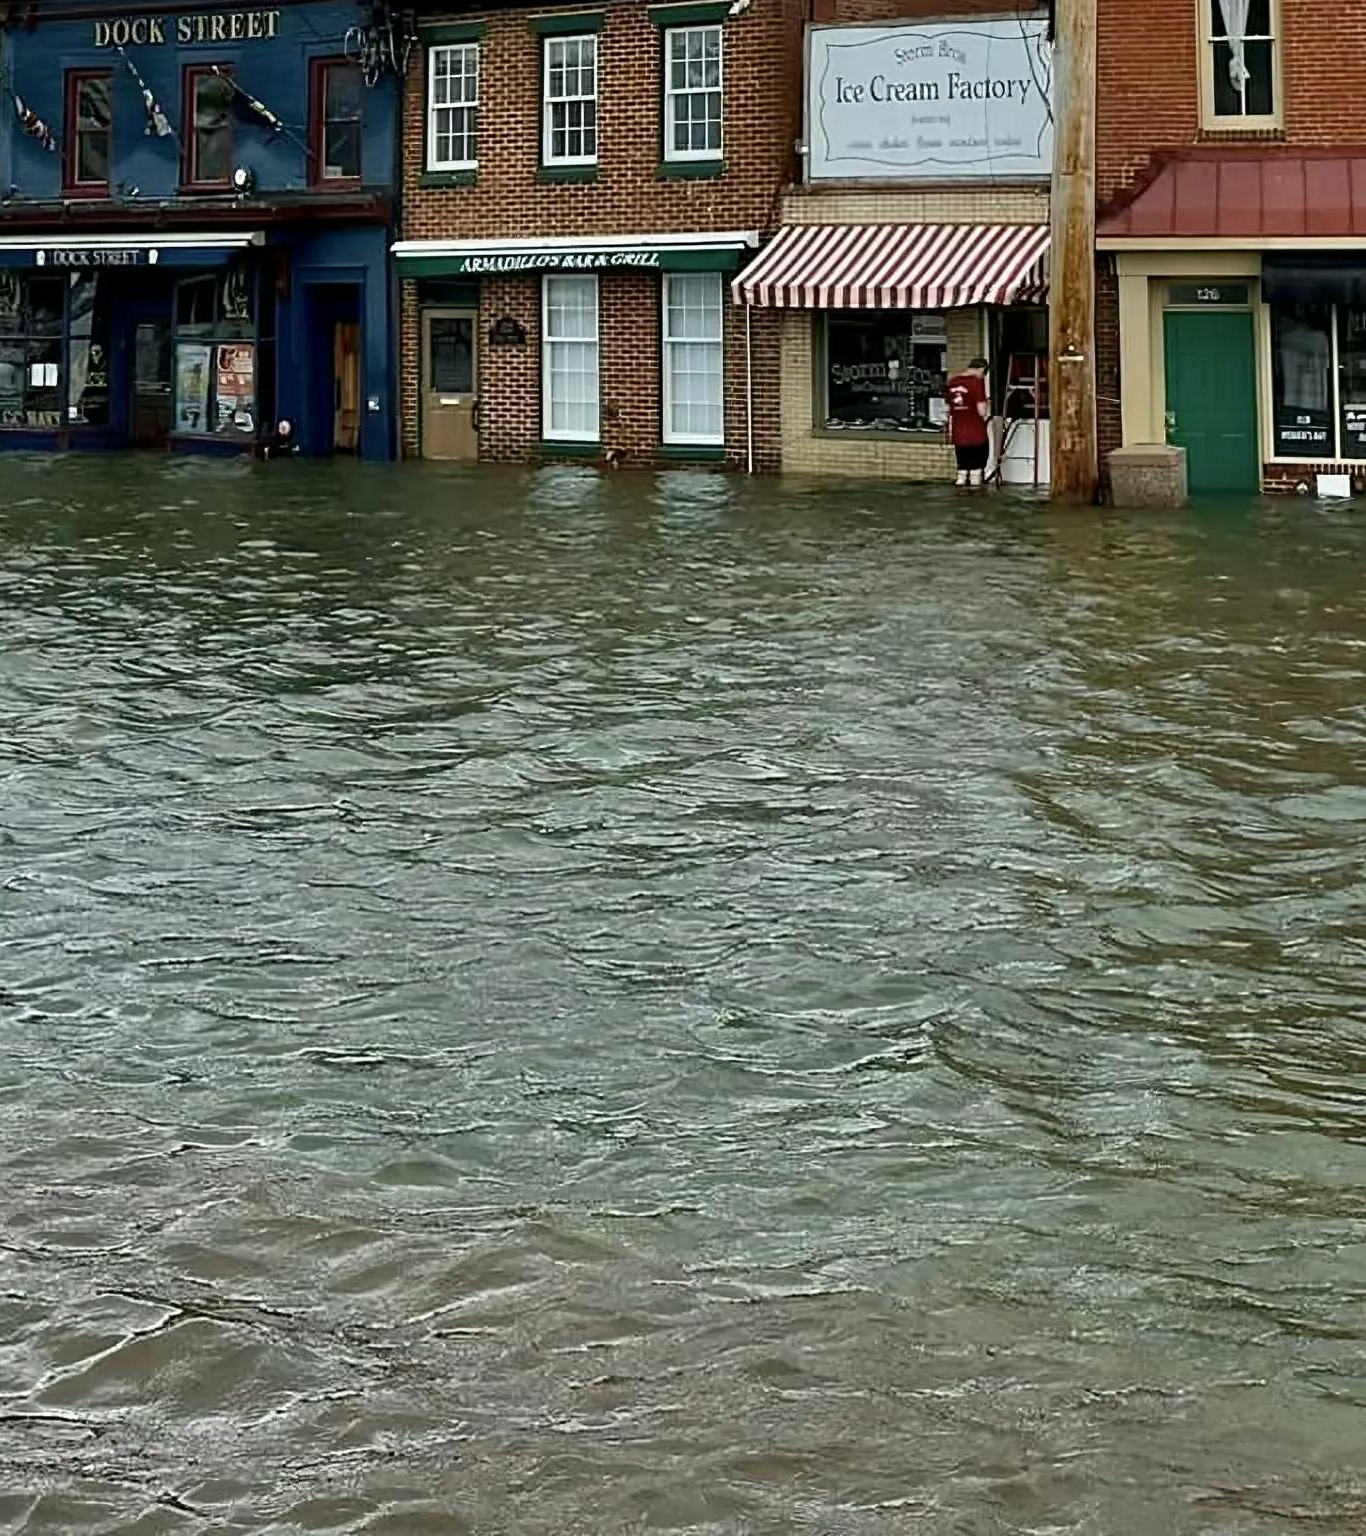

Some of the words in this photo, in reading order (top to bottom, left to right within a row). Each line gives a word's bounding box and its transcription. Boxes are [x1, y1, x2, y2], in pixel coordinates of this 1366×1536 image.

[94, 17, 164, 47] DOCK
[177, 11, 280, 43] STREET
[836, 76, 864, 103] Ice
[869, 74, 940, 103] Cream
[947, 72, 1031, 105] Factory
[610, 252, 660, 267] GRILL
